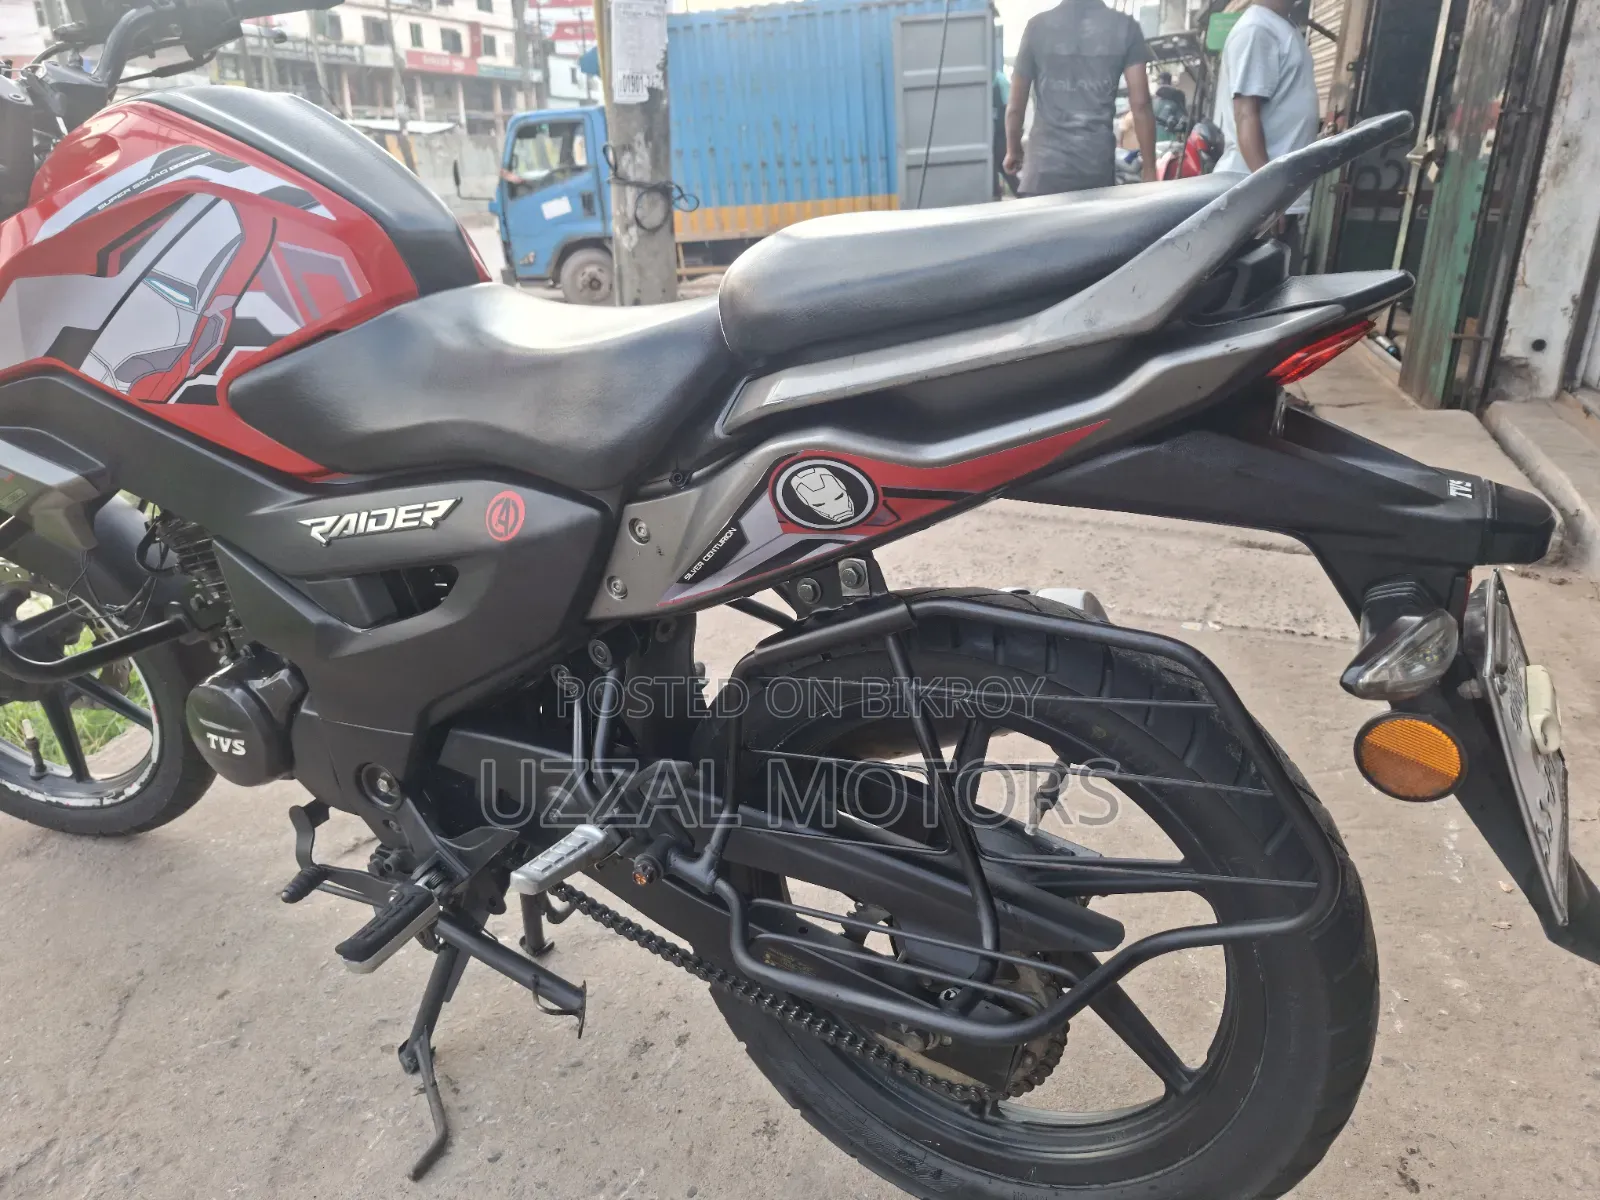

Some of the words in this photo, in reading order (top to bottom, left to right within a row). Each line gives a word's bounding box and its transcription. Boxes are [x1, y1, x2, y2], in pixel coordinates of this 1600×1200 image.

[97, 187, 132, 211] SUPER
[132, 168, 169, 190] SQUAD
[296, 496, 463, 547] RAIDER
[683, 560, 706, 581] SILVER
[702, 526, 738, 562] CENTURION
[206, 731, 247, 756] TVS
